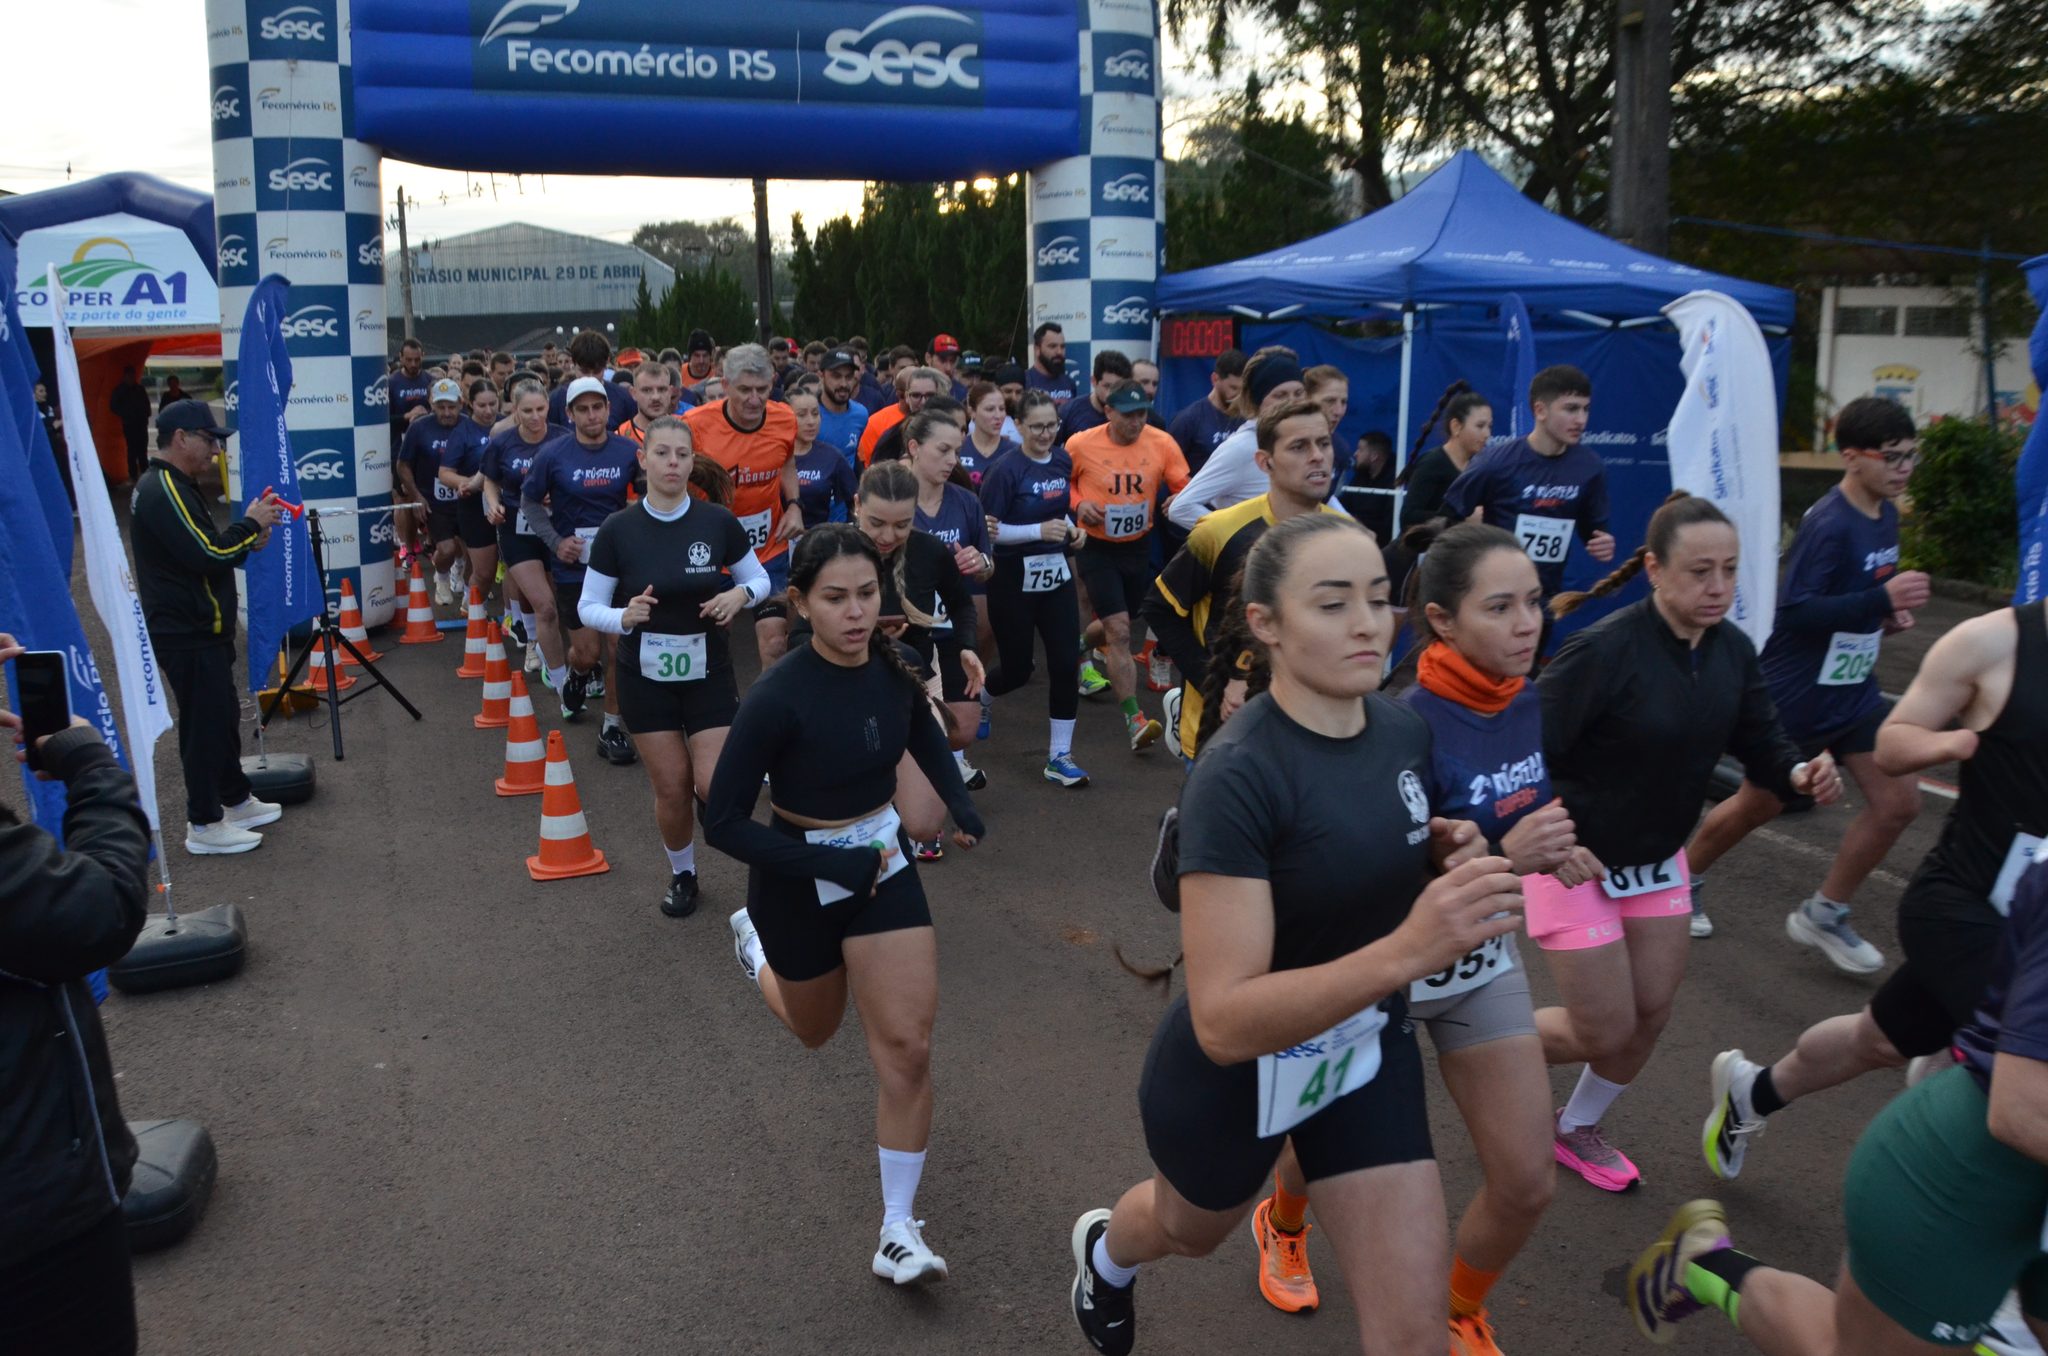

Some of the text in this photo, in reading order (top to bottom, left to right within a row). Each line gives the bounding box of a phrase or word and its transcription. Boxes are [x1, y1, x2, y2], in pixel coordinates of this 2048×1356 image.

[260, 16, 325, 41] Sesc
[507, 40, 776, 81] Fecomércio RS
[823, 28, 979, 89] Sesc
[262, 101, 337, 112] Fecomércio RS
[268, 169, 332, 191] Sesc
[1103, 181, 1149, 203] Sesc
[270, 250, 343, 260] Fecomércio RS
[358, 244, 383, 265] Ses
[1037, 245, 1080, 266] Sesc
[467, 267, 549, 284] MUNICIPAL
[556, 265, 575, 280] 29
[579, 265, 598, 279] DE
[17, 271, 187, 306] COPER A1
[1103, 305, 1150, 324] Sesc
[364, 386, 388, 406] Ses
[278, 414, 291, 485] Sindicatos
[438, 487, 457, 499] 93
[1108, 473, 1144, 495] JR
[1111, 513, 1144, 534] 789
[1523, 532, 1562, 558] 758
[1030, 567, 1065, 589] 754
[657, 652, 691, 677] 30
[1297, 1046, 1355, 1108] 41
